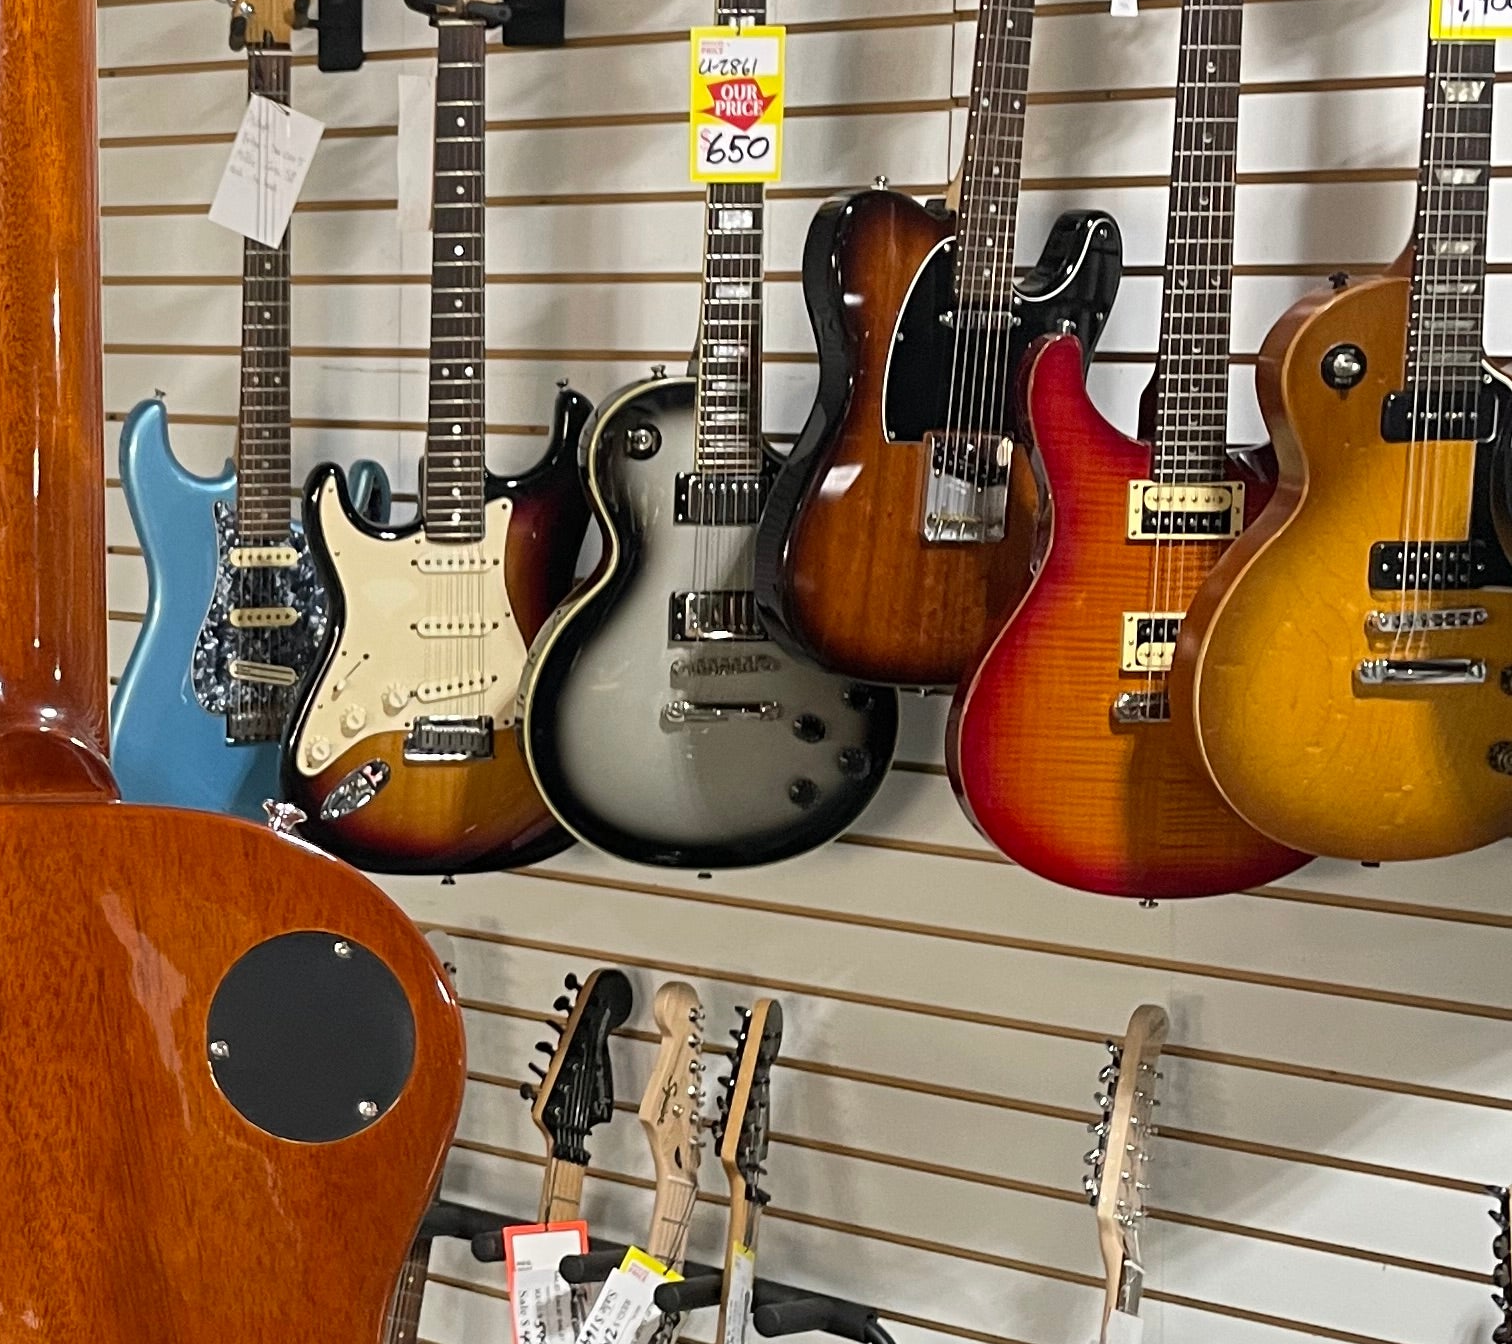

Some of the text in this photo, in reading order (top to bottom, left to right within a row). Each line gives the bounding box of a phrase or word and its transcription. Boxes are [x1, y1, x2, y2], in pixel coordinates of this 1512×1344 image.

[720, 83, 758, 101] OUR
[715, 100, 764, 116] PRICE
[700, 128, 769, 164] $650
